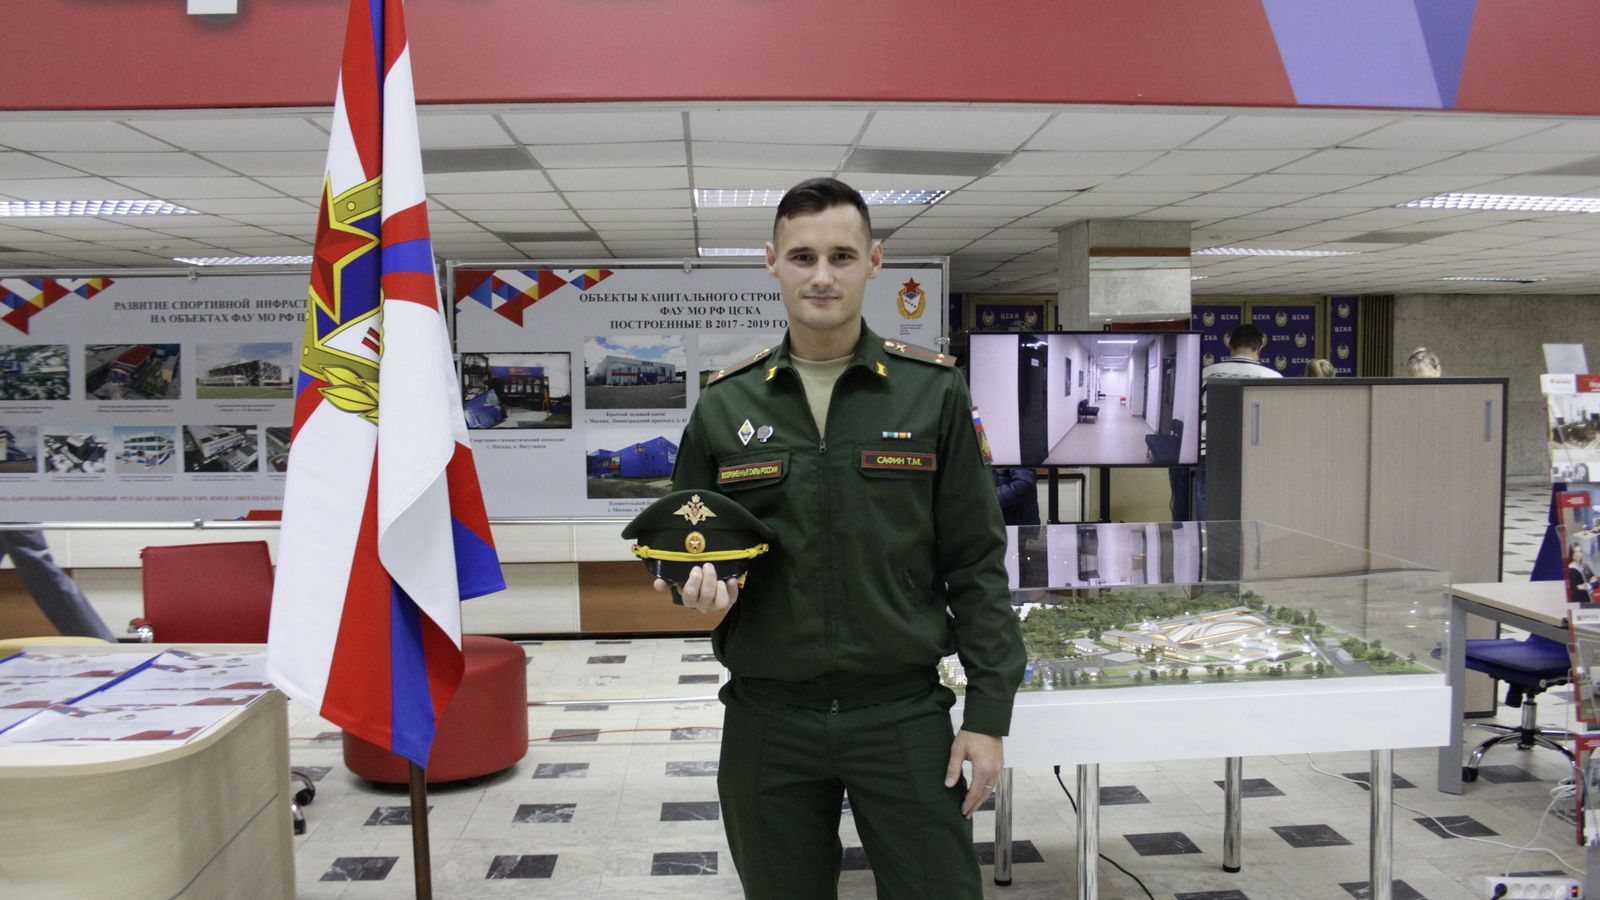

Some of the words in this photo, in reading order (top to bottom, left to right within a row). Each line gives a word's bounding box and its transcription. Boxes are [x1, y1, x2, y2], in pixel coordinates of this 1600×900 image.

[579, 293, 638, 303] ОБЪЕКТЫ
[641, 292, 738, 302] КАПИТАЛЬНОГО
[741, 292, 781, 302] СТРОИ
[114, 301, 168, 311] РАЗВИТИЕ
[171, 299, 250, 310] СПОРТИВНОЙ
[256, 299, 307, 309] ИНФРАСТ
[660, 306, 684, 316] ФАУ
[687, 306, 707, 316] МО
[709, 306, 726, 316] РФ
[728, 306, 761, 317] ЦСКА
[150, 314, 167, 324] НА
[169, 313, 229, 324] ОБЪЕКТАХ
[231, 313, 254, 323] ФАУ
[257, 313, 276, 322] МО
[278, 313, 294, 322] РФ
[610, 320, 702, 330] ПОСТРОЕННЫЕ
[705, 320, 713, 329] В
[715, 320, 738, 329] 2017
[747, 319, 770, 329] 2019
[772, 319, 788, 329] ГО
[876, 456, 905, 465] САФИН
